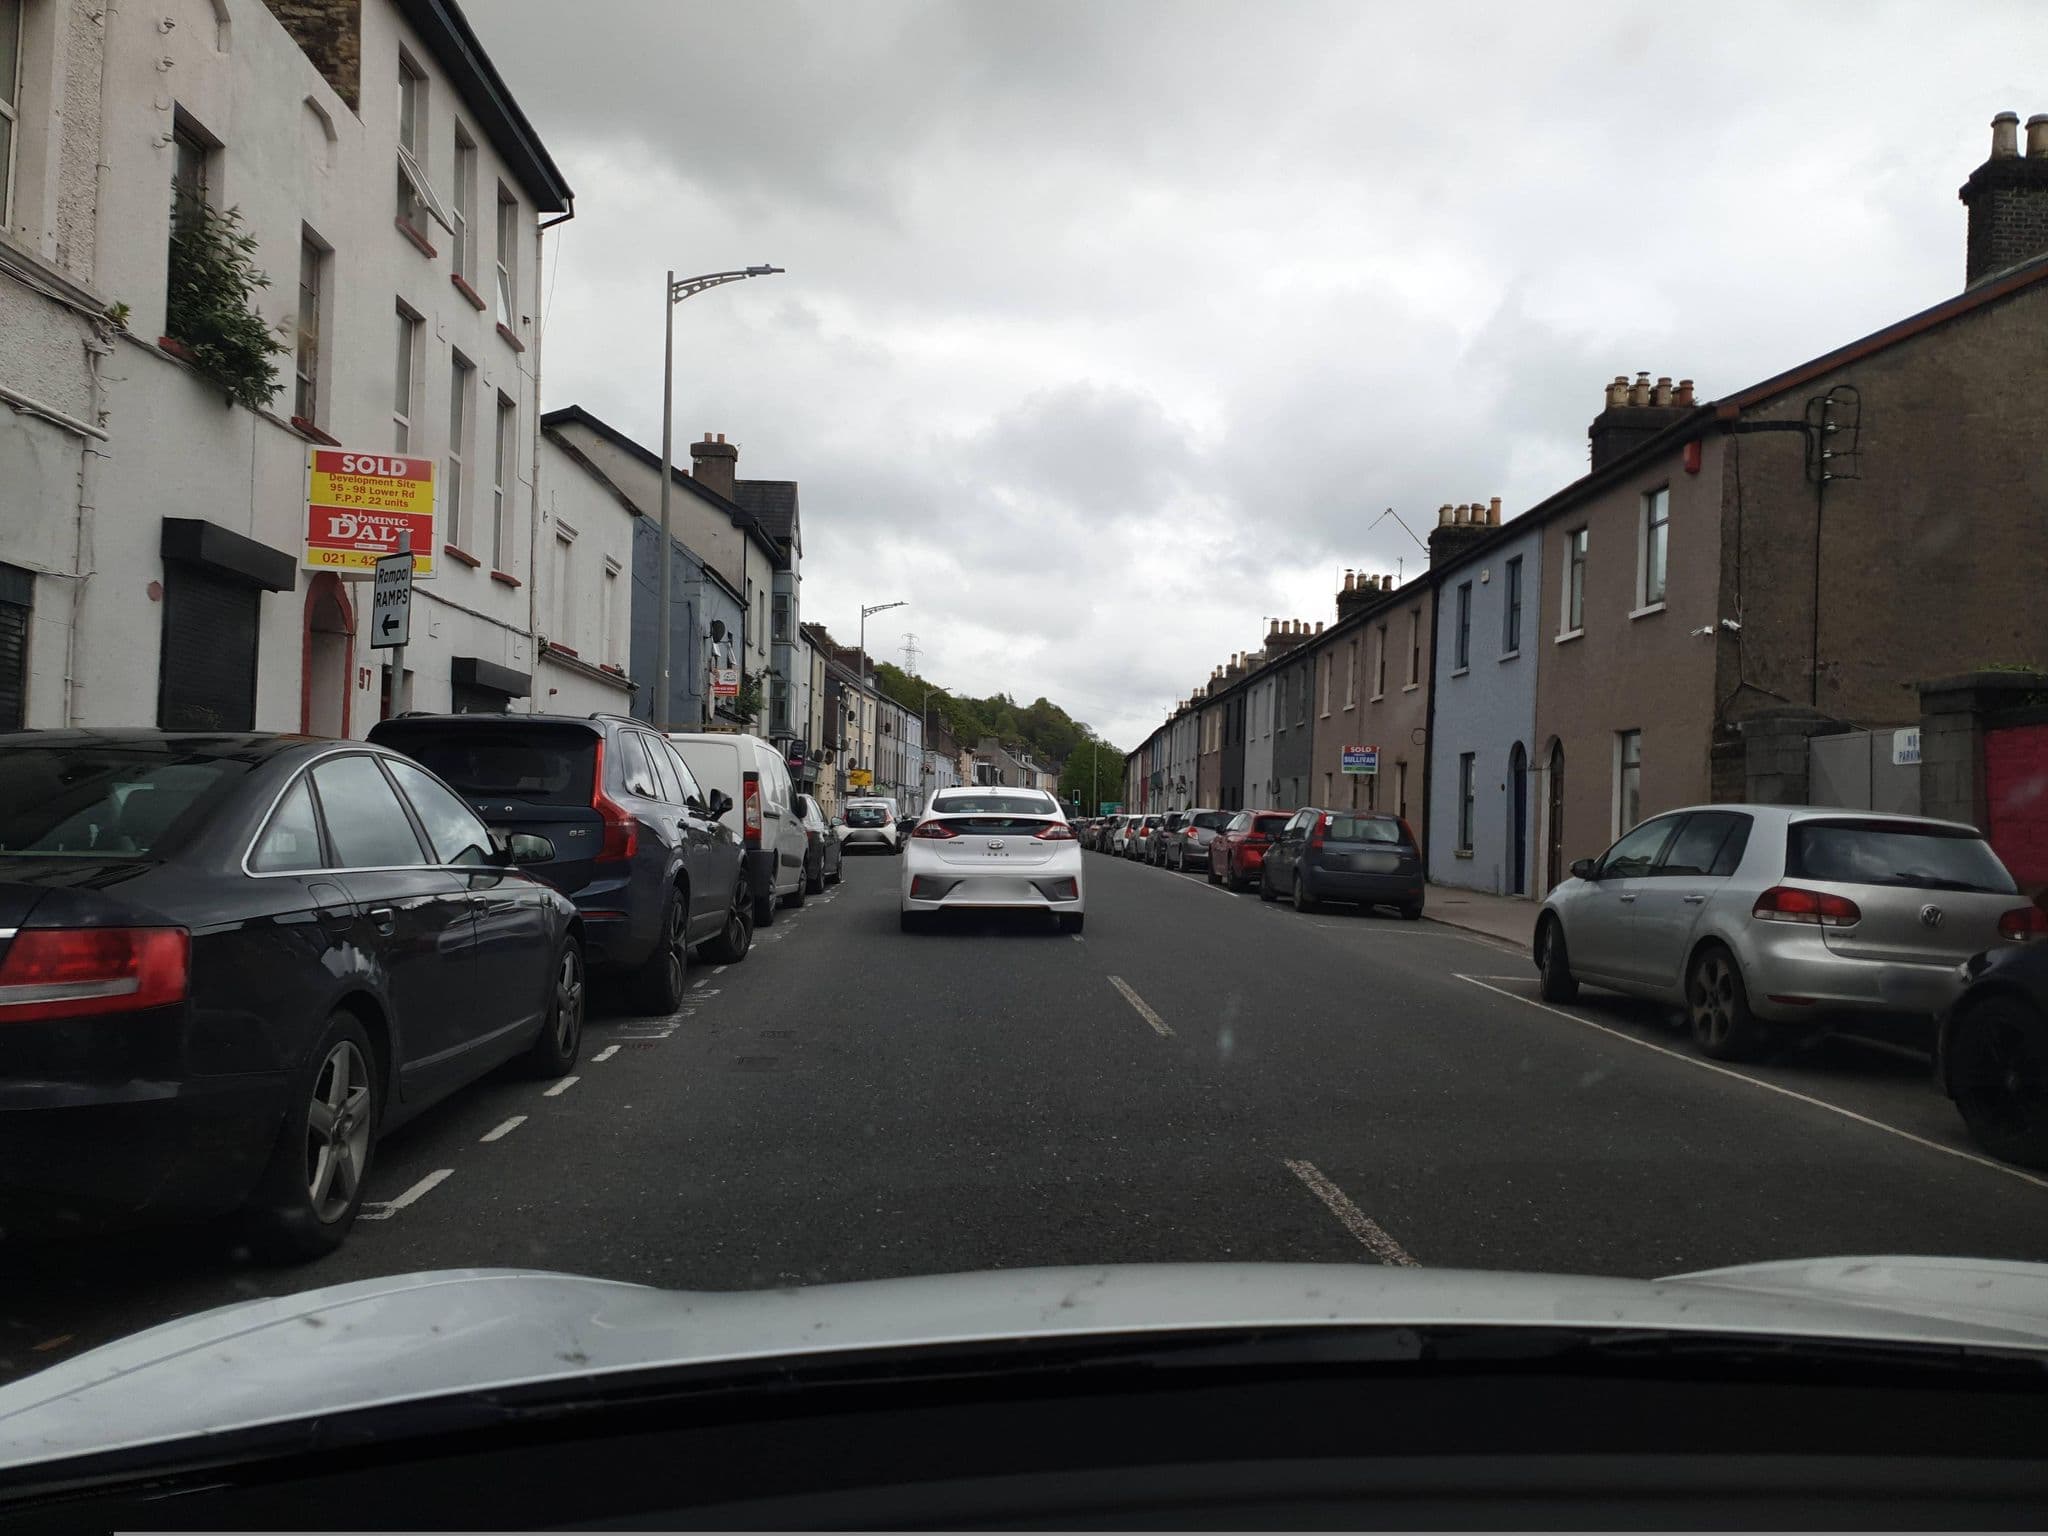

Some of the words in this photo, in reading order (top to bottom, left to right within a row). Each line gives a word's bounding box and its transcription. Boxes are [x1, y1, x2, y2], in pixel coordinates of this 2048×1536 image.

[342, 455, 407, 477] SOLD
[330, 473, 393, 487] Development
[397, 479, 416, 489] Site
[330, 483, 344, 492] 95
[353, 485, 366, 494] 98
[369, 487, 399, 497] Lower
[402, 490, 415, 499] Rd
[335, 493, 365, 504] F.P.P.
[368, 496, 382, 505] 22
[385, 498, 409, 508] units
[340, 513, 409, 527] DOMINIC
[322, 552, 346, 564] 021
[376, 588, 408, 608] RAMPS
[359, 667, 371, 691] 97
[1899, 750, 1920, 763] PARKIN
